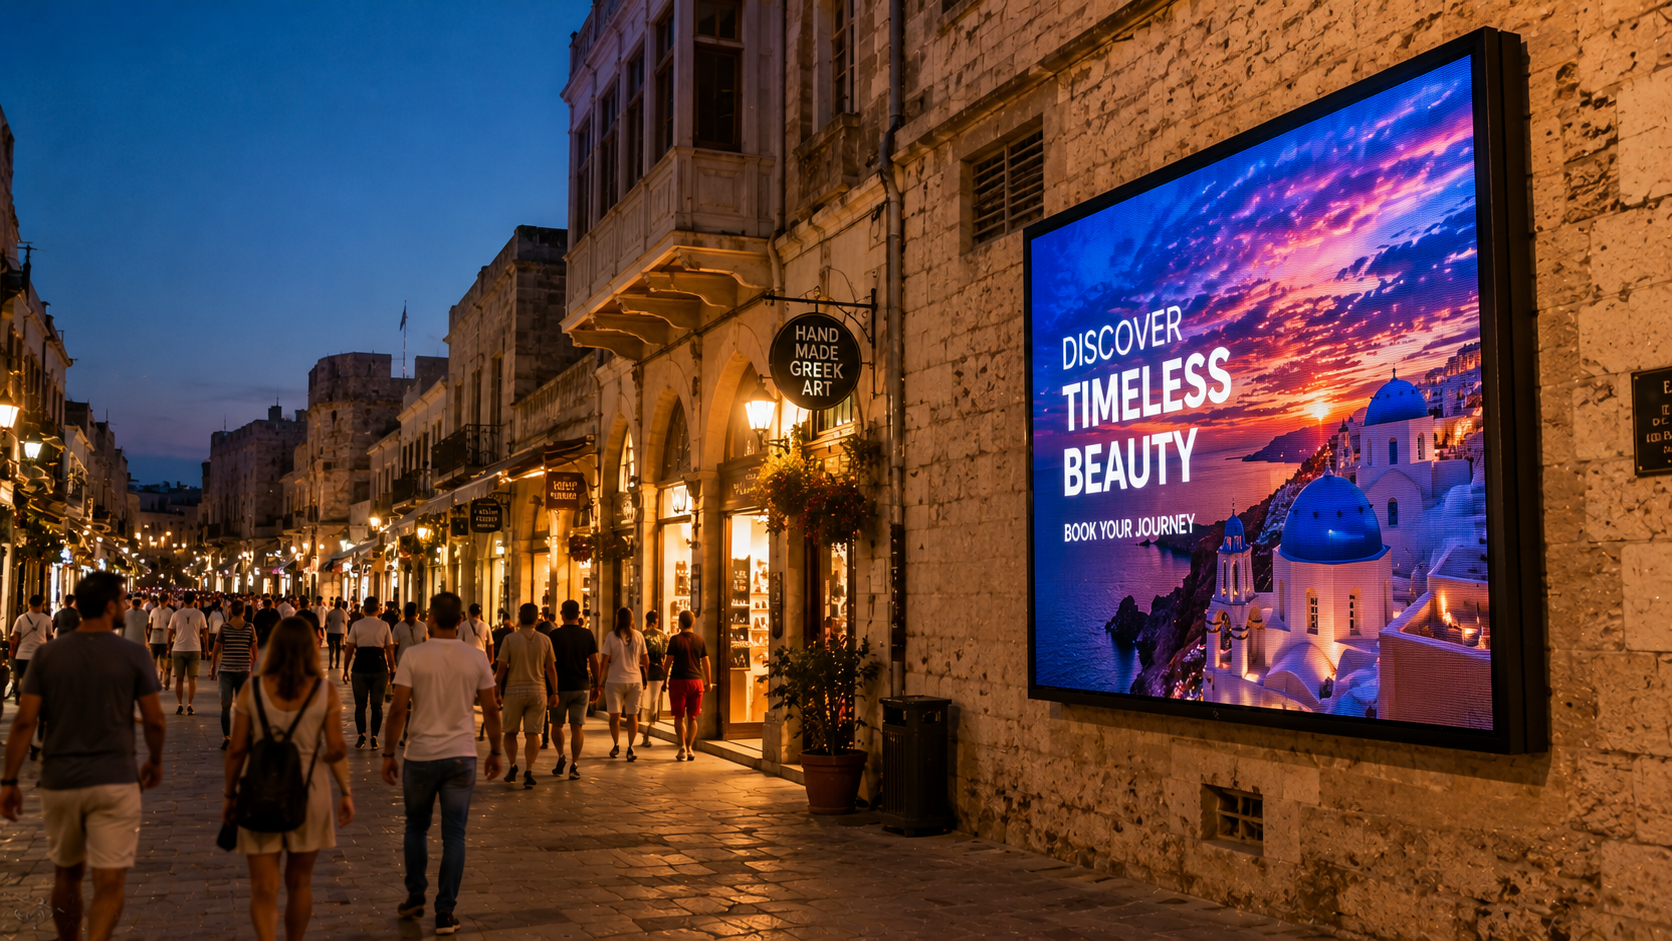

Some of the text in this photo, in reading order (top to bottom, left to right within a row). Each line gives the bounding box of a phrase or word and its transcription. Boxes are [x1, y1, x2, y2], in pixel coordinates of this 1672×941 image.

[795, 325, 839, 343] HAND
[1062, 305, 1182, 370] DISCOVER
[795, 343, 839, 360] MADE
[789, 360, 844, 379] GREEK
[801, 379, 833, 397] ART
[1062, 346, 1232, 432] TIMELESS
[1063, 427, 1199, 497] BEAUTY
[1064, 513, 1196, 543] BOOK YOUR JOURNEY
